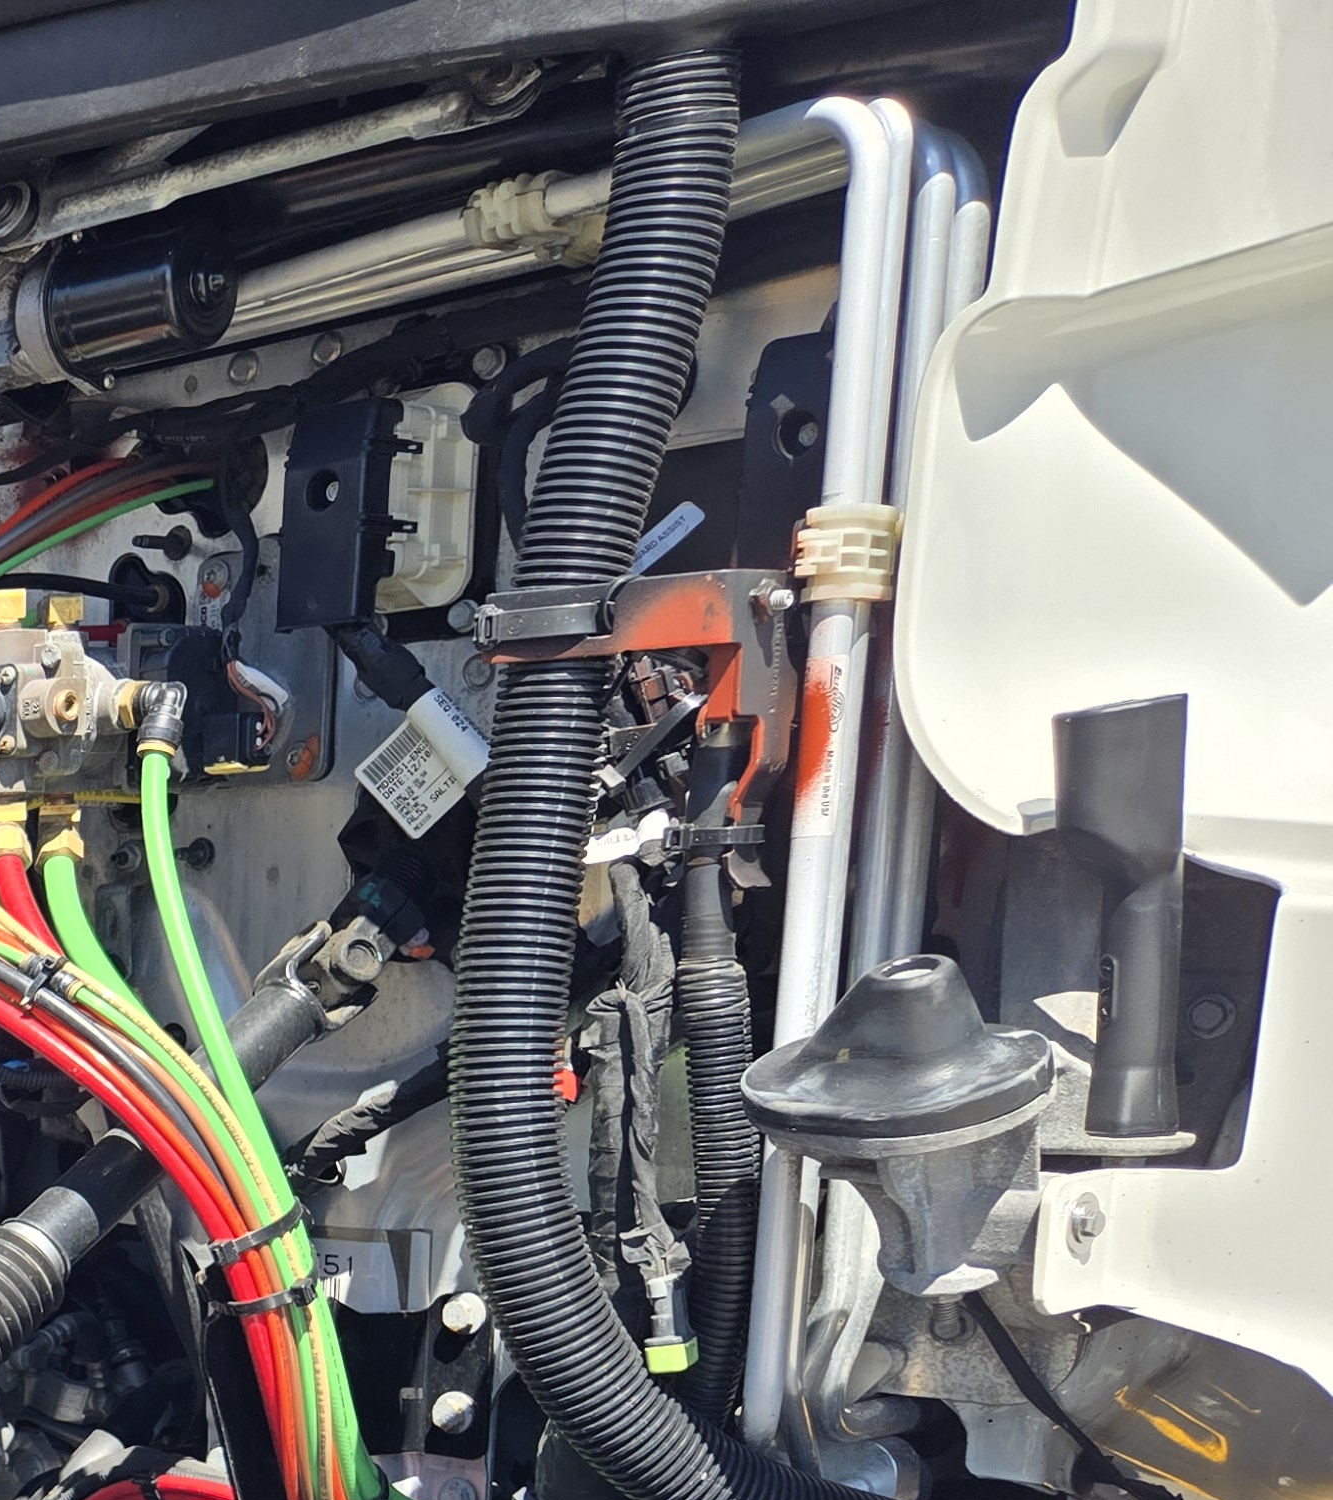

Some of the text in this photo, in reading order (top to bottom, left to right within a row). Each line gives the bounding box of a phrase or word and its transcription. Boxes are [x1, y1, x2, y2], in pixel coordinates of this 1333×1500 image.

[657, 515, 687, 541] ASSIST
[433, 693, 470, 734] SEQ.024
[317, 1252, 353, 1277] 51
